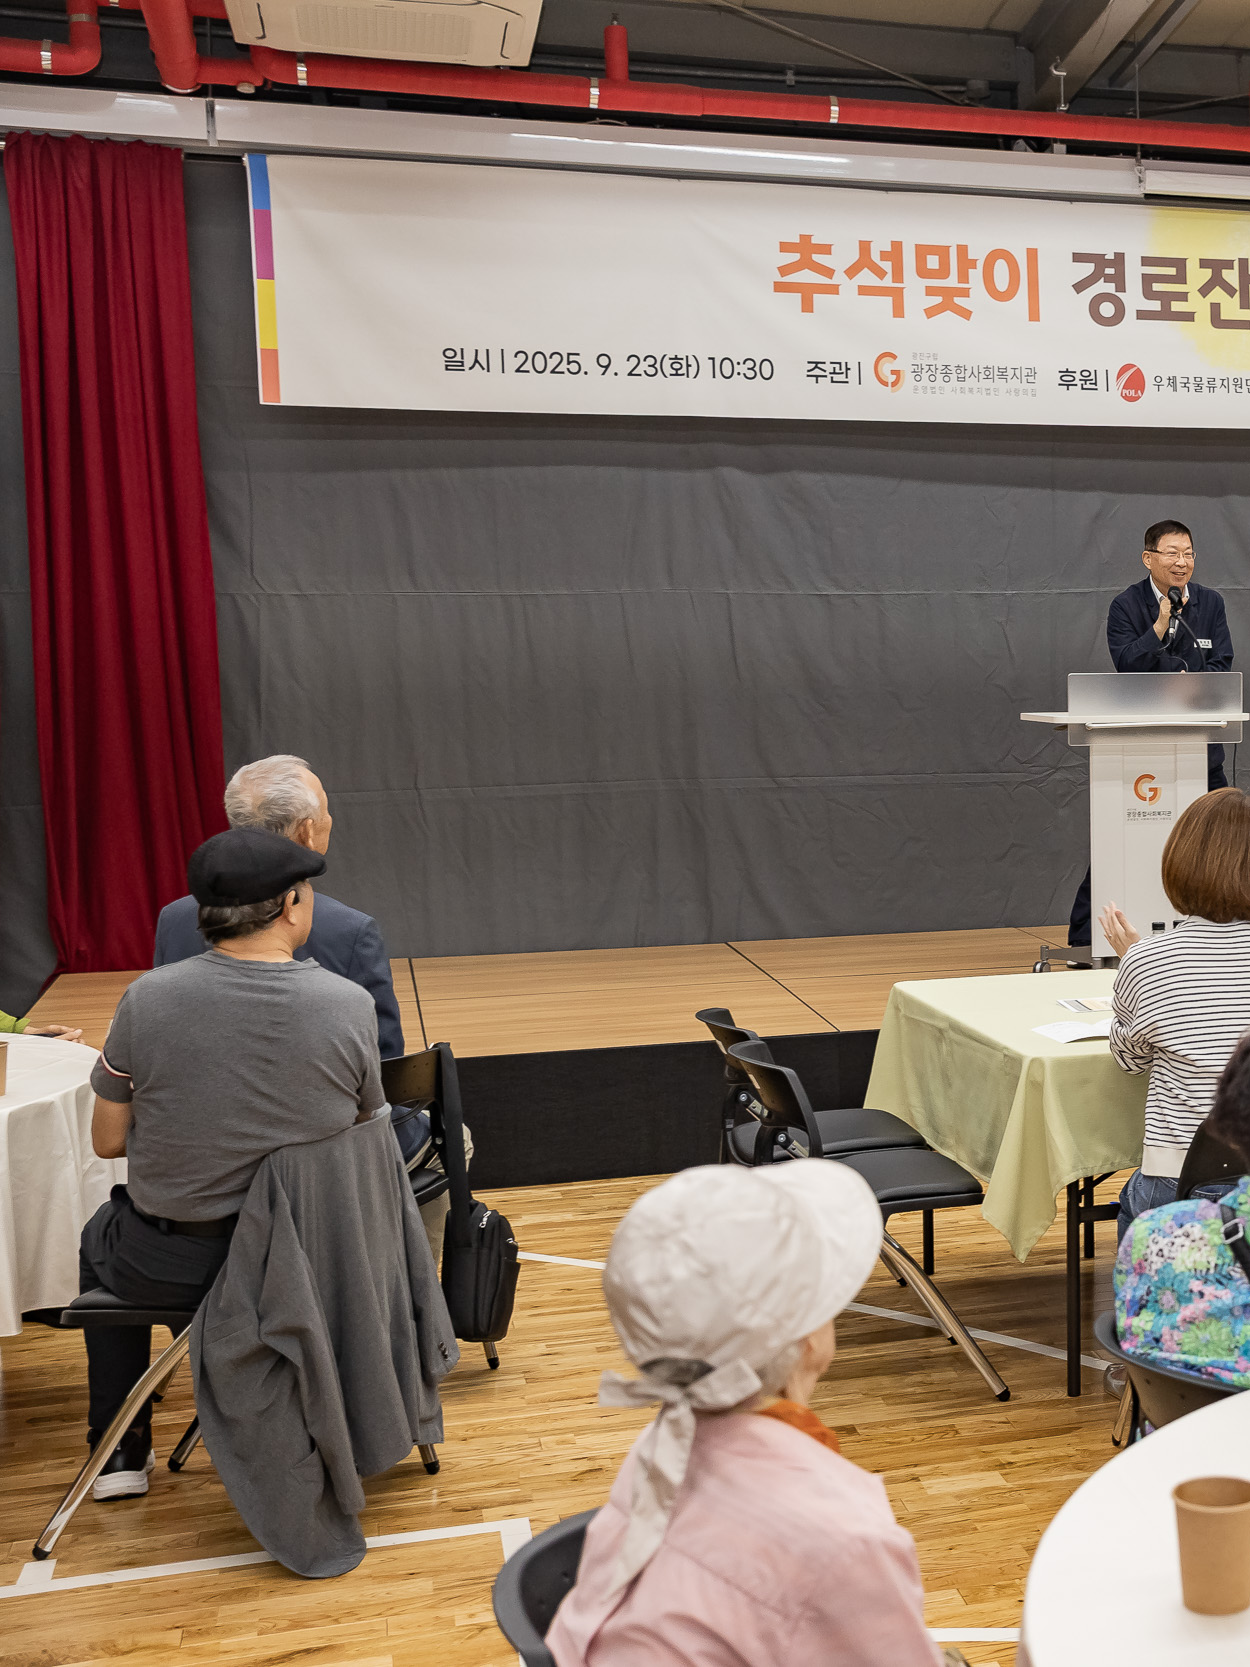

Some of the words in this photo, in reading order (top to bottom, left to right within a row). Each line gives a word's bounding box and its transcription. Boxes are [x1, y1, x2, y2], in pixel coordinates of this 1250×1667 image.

[772, 233, 1041, 323] 추석맞이
[441, 347, 491, 373] 일시
[513, 350, 589, 376] 2025.
[596, 353, 619, 377] 9.
[626, 353, 701, 379] 23(화)
[707, 356, 775, 381] 10:30
[805, 360, 851, 385] 주관
[910, 363, 1038, 385] 광장종합사회복지관
[1057, 368, 1099, 391] 후원
[1122, 388, 1144, 397] POLA
